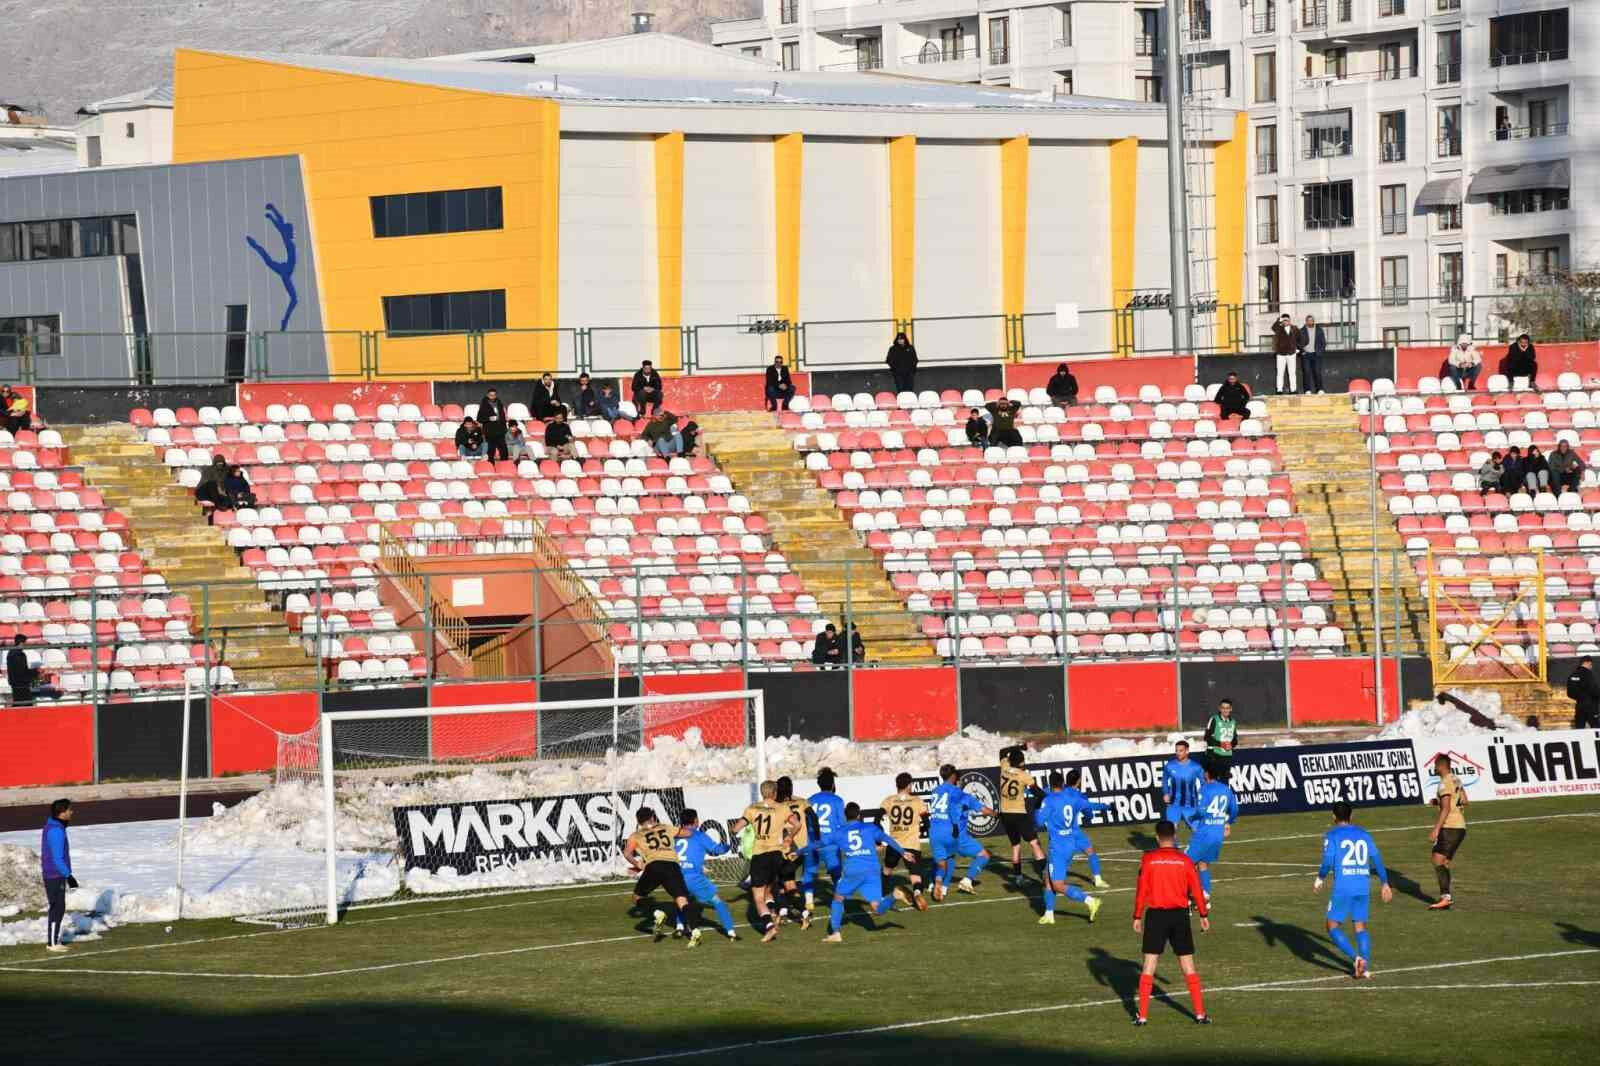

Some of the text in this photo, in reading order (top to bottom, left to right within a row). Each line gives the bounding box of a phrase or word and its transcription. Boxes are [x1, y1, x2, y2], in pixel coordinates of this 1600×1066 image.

[1301, 753, 1386, 774] REKLAMLARINIZ
[1001, 776, 1020, 798] 76
[1098, 761, 1169, 791] MADE
[1252, 792, 1279, 804] MEDYA
[1303, 772, 1420, 804] 0552 372 65 65
[890, 805, 914, 826] 99
[1063, 804, 1074, 827] 9
[1206, 795, 1228, 818] 42
[407, 793, 677, 857] MARKASYA
[755, 813, 771, 835] 11
[644, 829, 671, 850] 55
[847, 829, 862, 850] 5
[1340, 839, 1369, 866] 20
